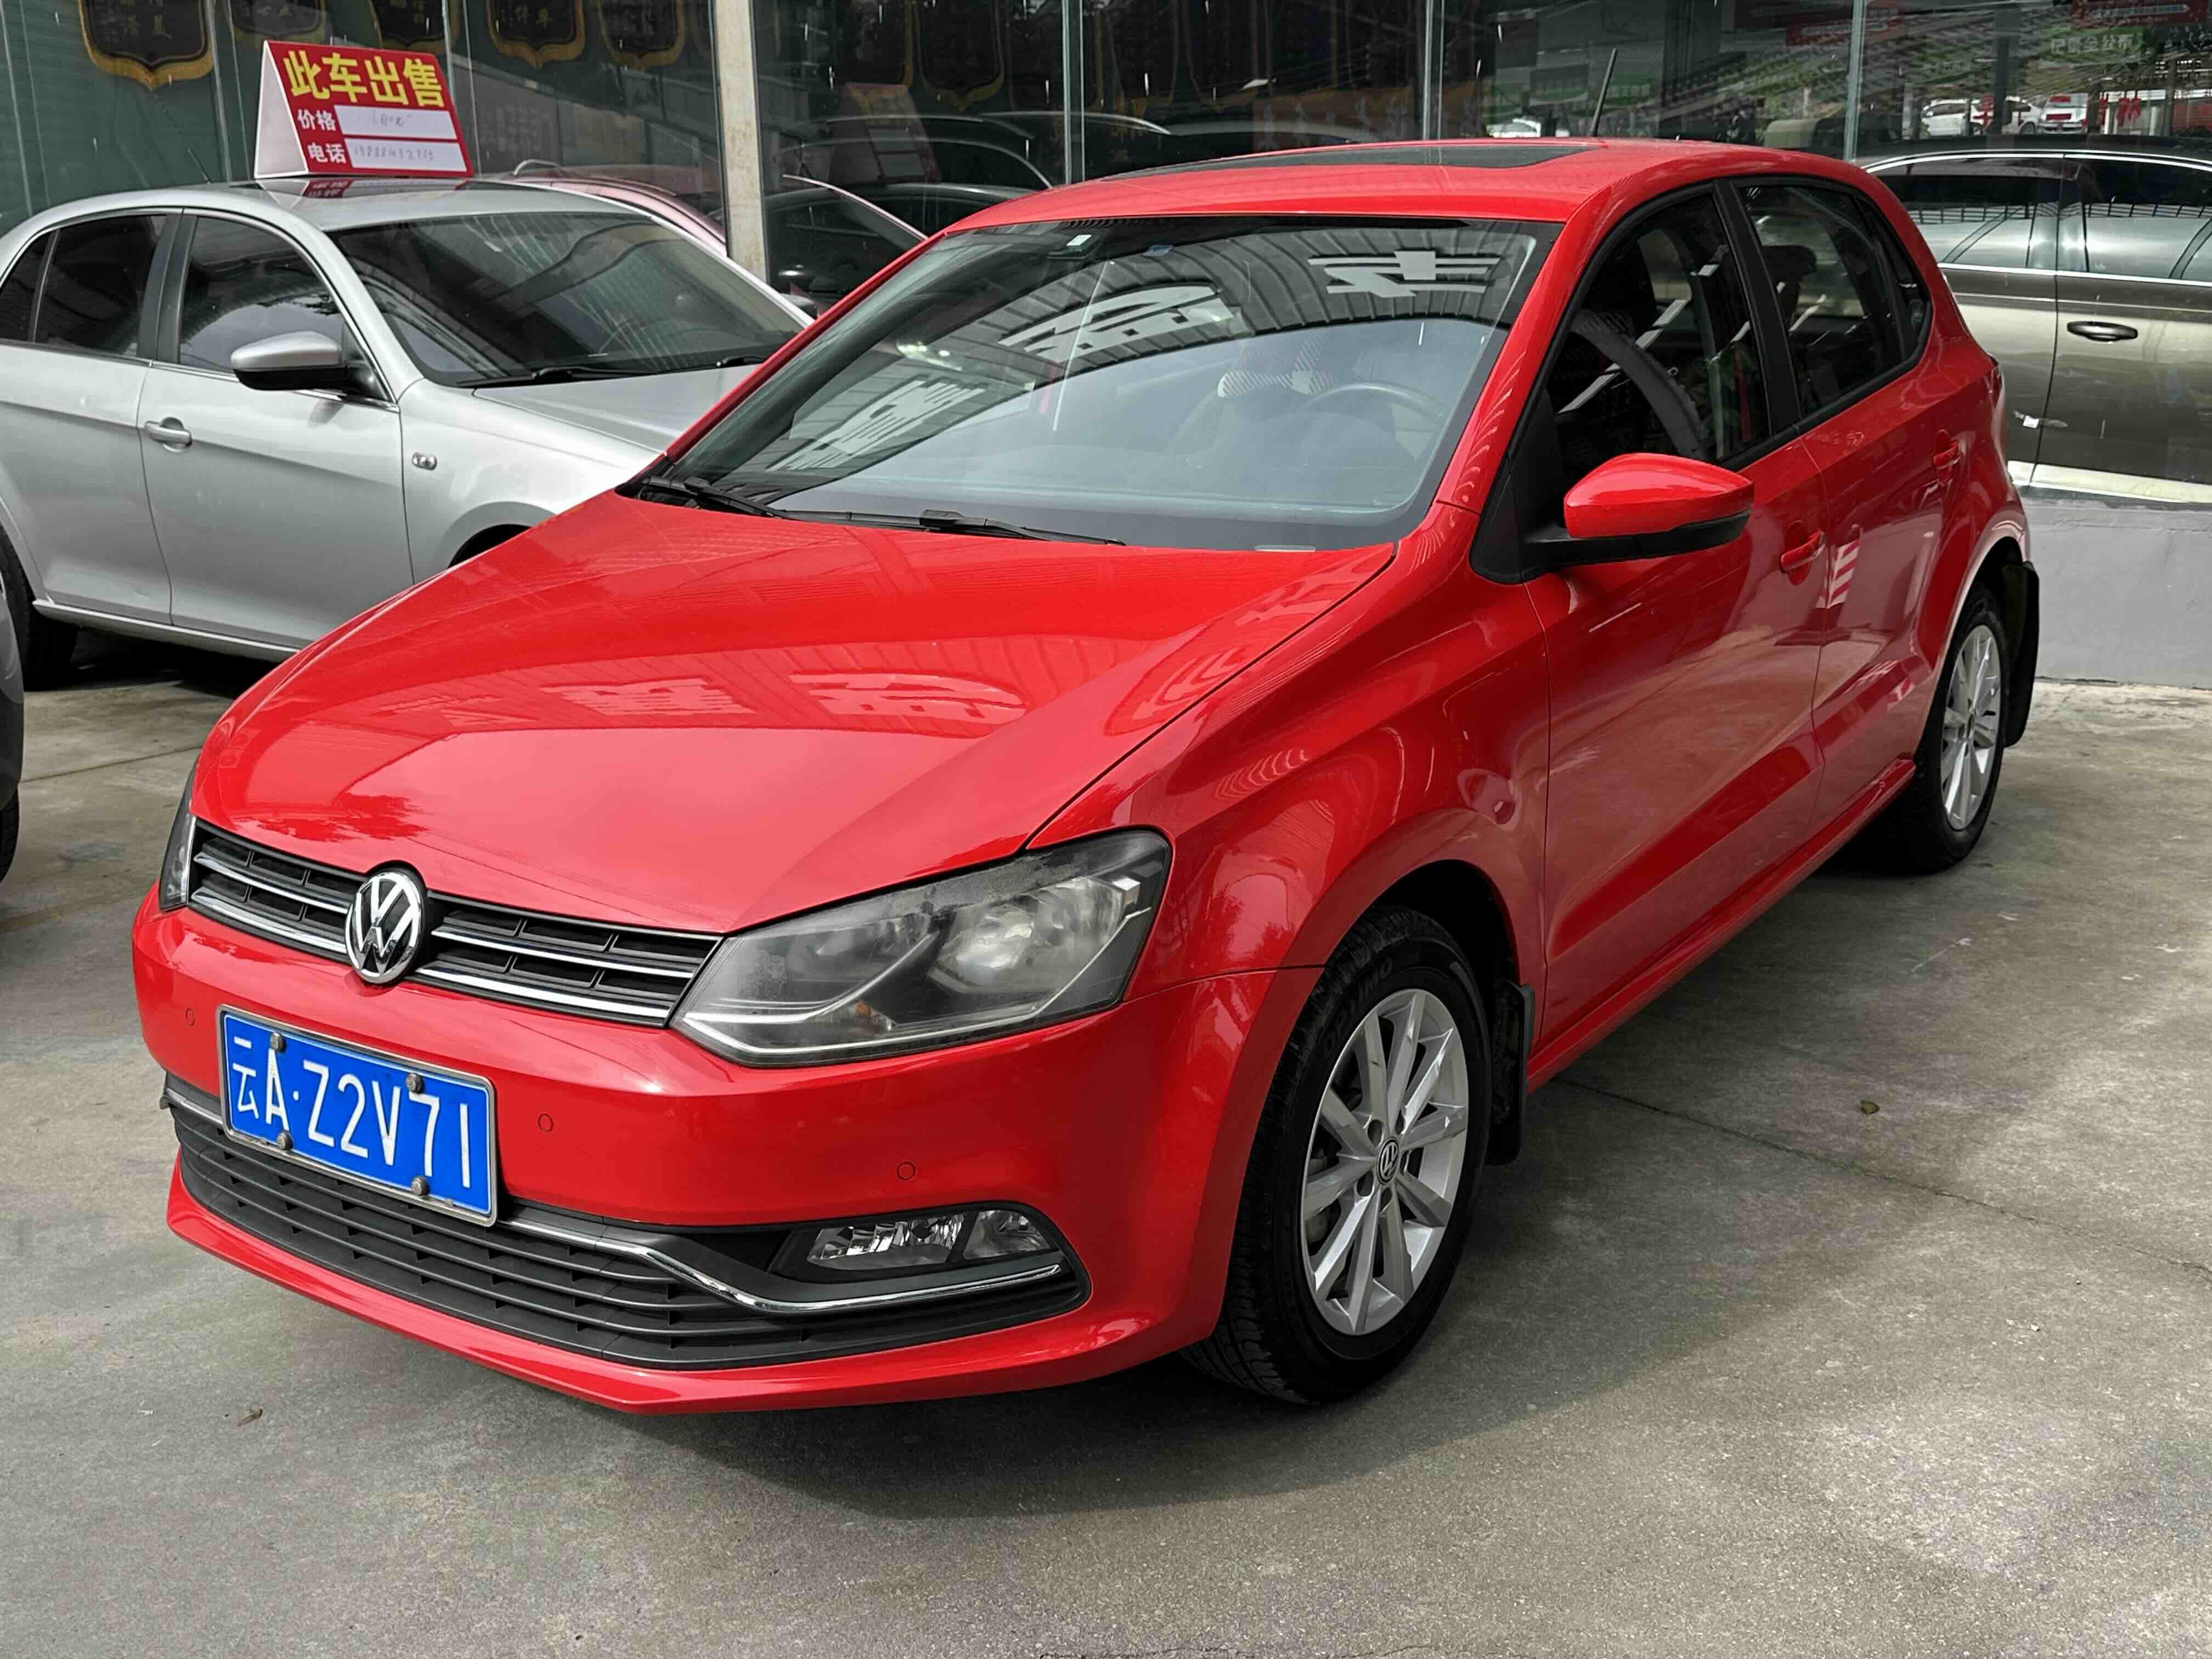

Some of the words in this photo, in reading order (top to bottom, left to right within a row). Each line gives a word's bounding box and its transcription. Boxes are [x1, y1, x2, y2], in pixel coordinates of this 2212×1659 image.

[283, 50, 444, 108] 此车出售
[297, 109, 336, 131] 价格
[307, 142, 347, 163] 电话
